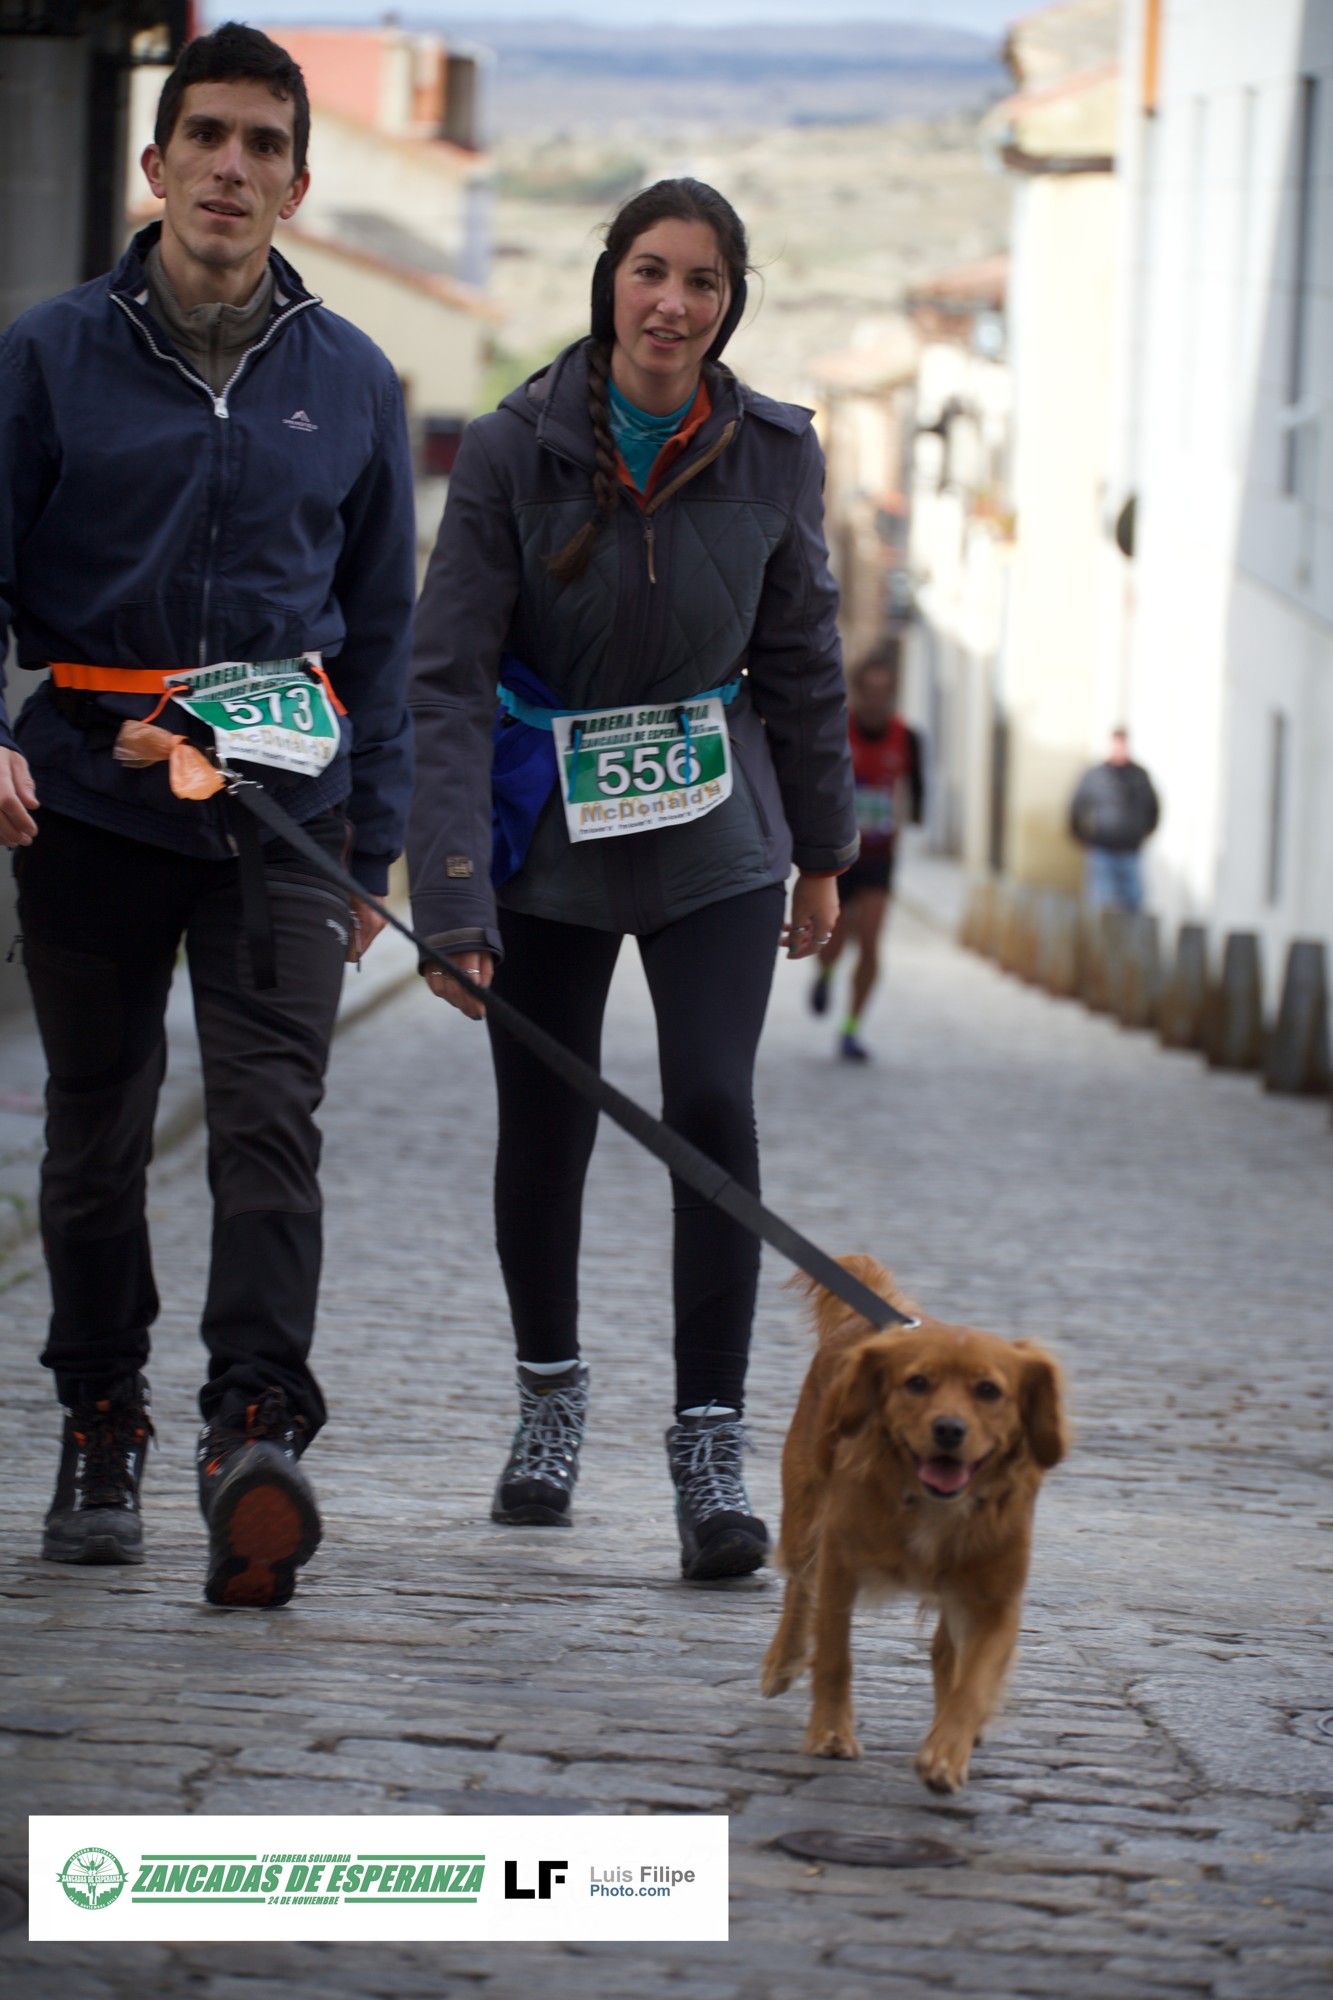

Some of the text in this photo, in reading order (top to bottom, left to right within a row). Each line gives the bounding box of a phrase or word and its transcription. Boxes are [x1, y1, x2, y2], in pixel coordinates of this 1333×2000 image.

[221, 687, 314, 731] 573
[597, 742, 702, 796] 556
[579, 780, 722, 825] McDonald's
